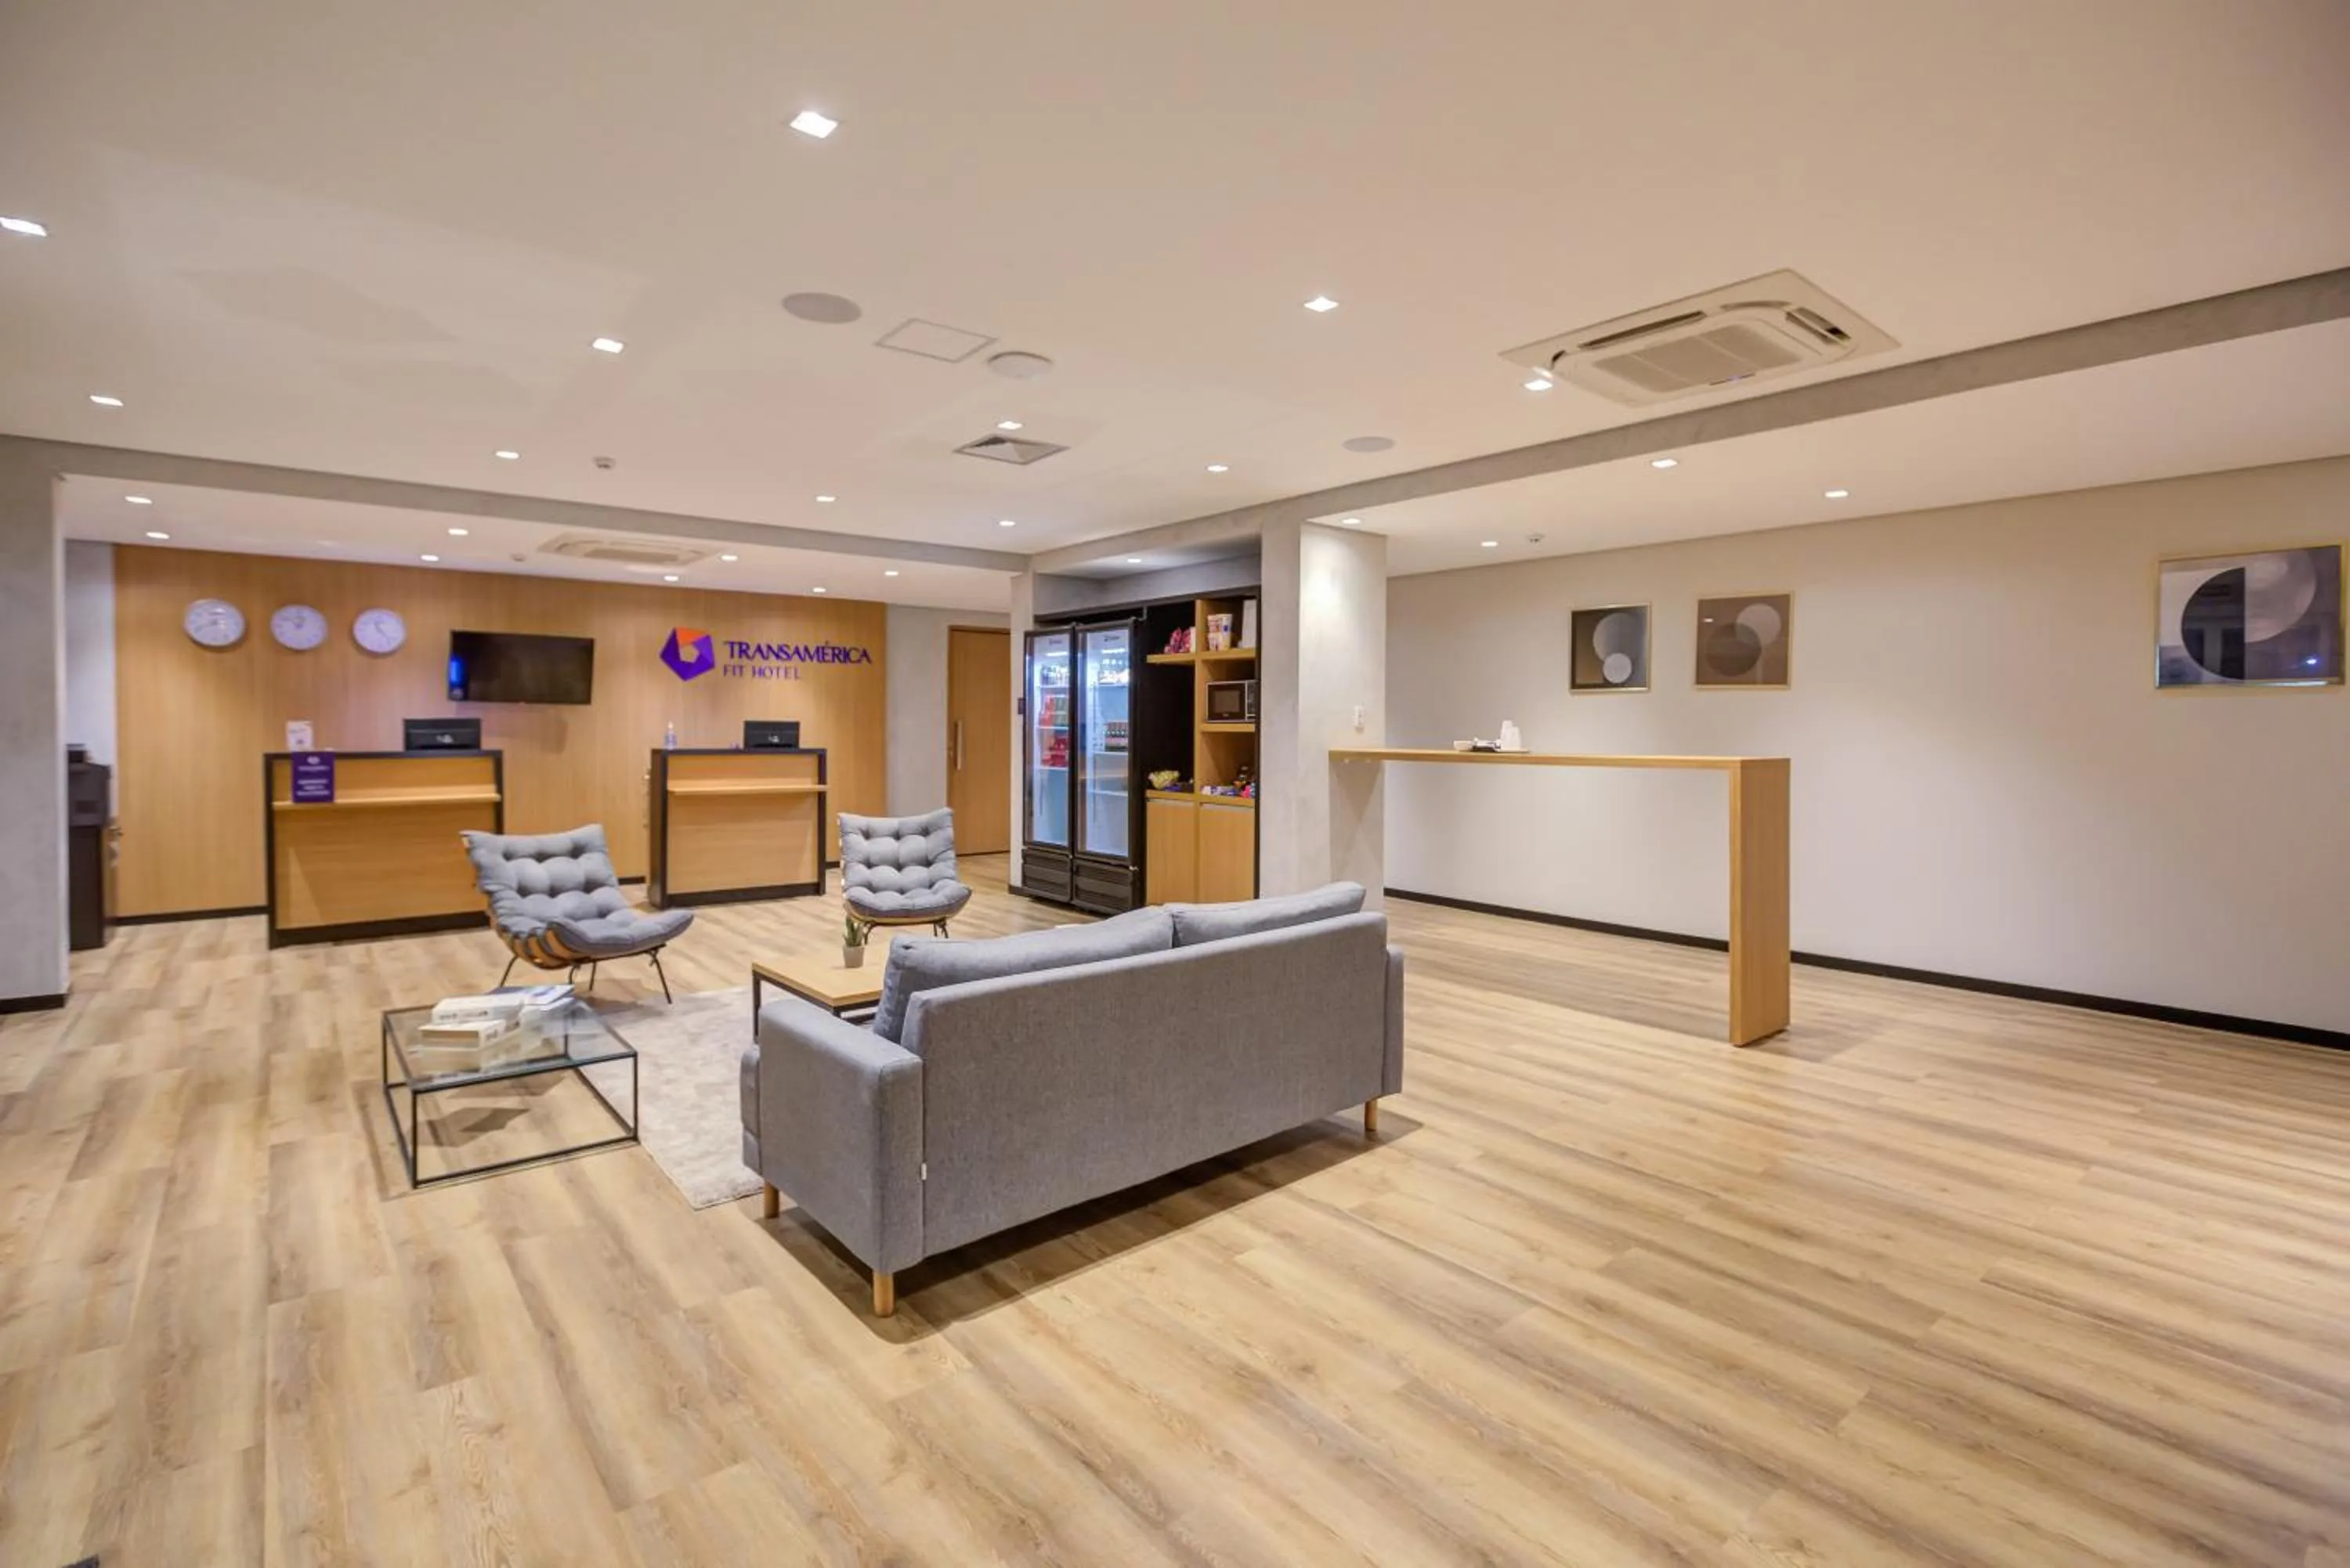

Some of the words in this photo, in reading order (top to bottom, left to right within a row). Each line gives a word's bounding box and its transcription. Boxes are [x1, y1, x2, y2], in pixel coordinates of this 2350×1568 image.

[723, 640, 872, 664] TRANSAMÉRICA
[724, 664, 746, 677] FIT
[752, 665, 801, 679] HOTEL
